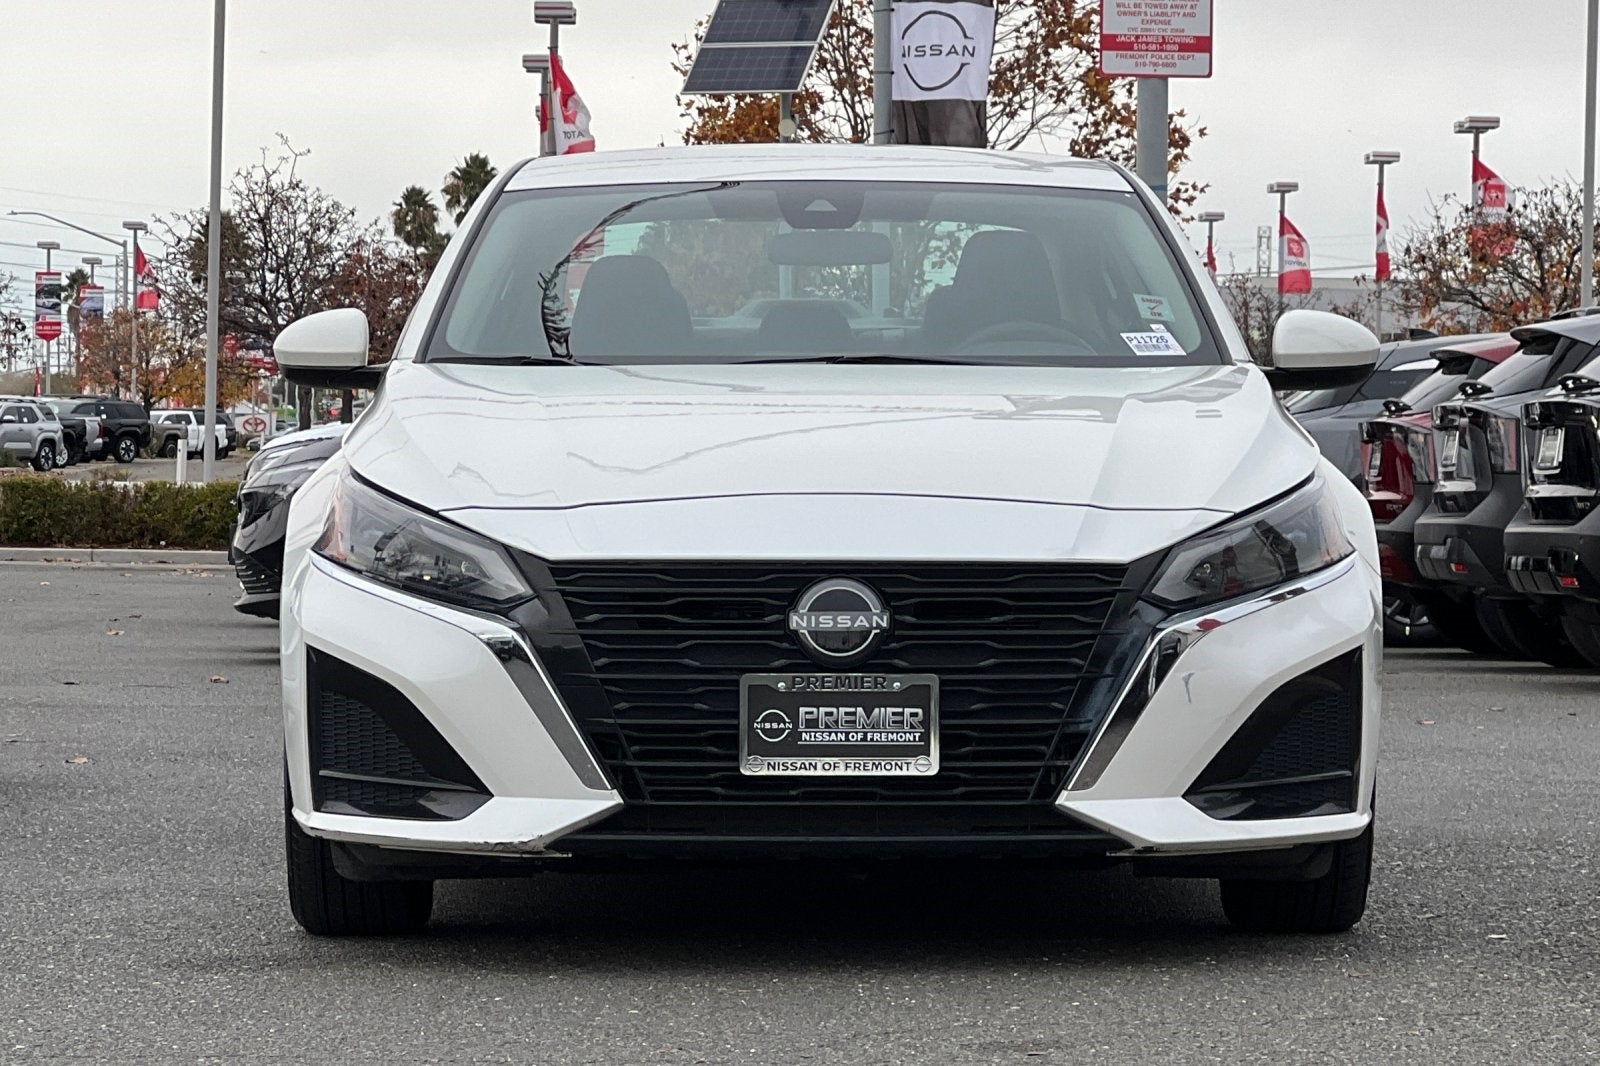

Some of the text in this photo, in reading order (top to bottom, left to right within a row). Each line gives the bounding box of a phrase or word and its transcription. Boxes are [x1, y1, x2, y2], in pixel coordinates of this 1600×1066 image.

[1115, 52, 1149, 60] FREMONT
[792, 615, 888, 628] NISSAN
[791, 675, 888, 691] PREMIER
[799, 707, 924, 730] PREMIER
[753, 722, 793, 730] NISSAN
[801, 732, 921, 742] NISSAN OF FREMONT
[766, 761, 913, 772] NISSAN OF FREMONT
